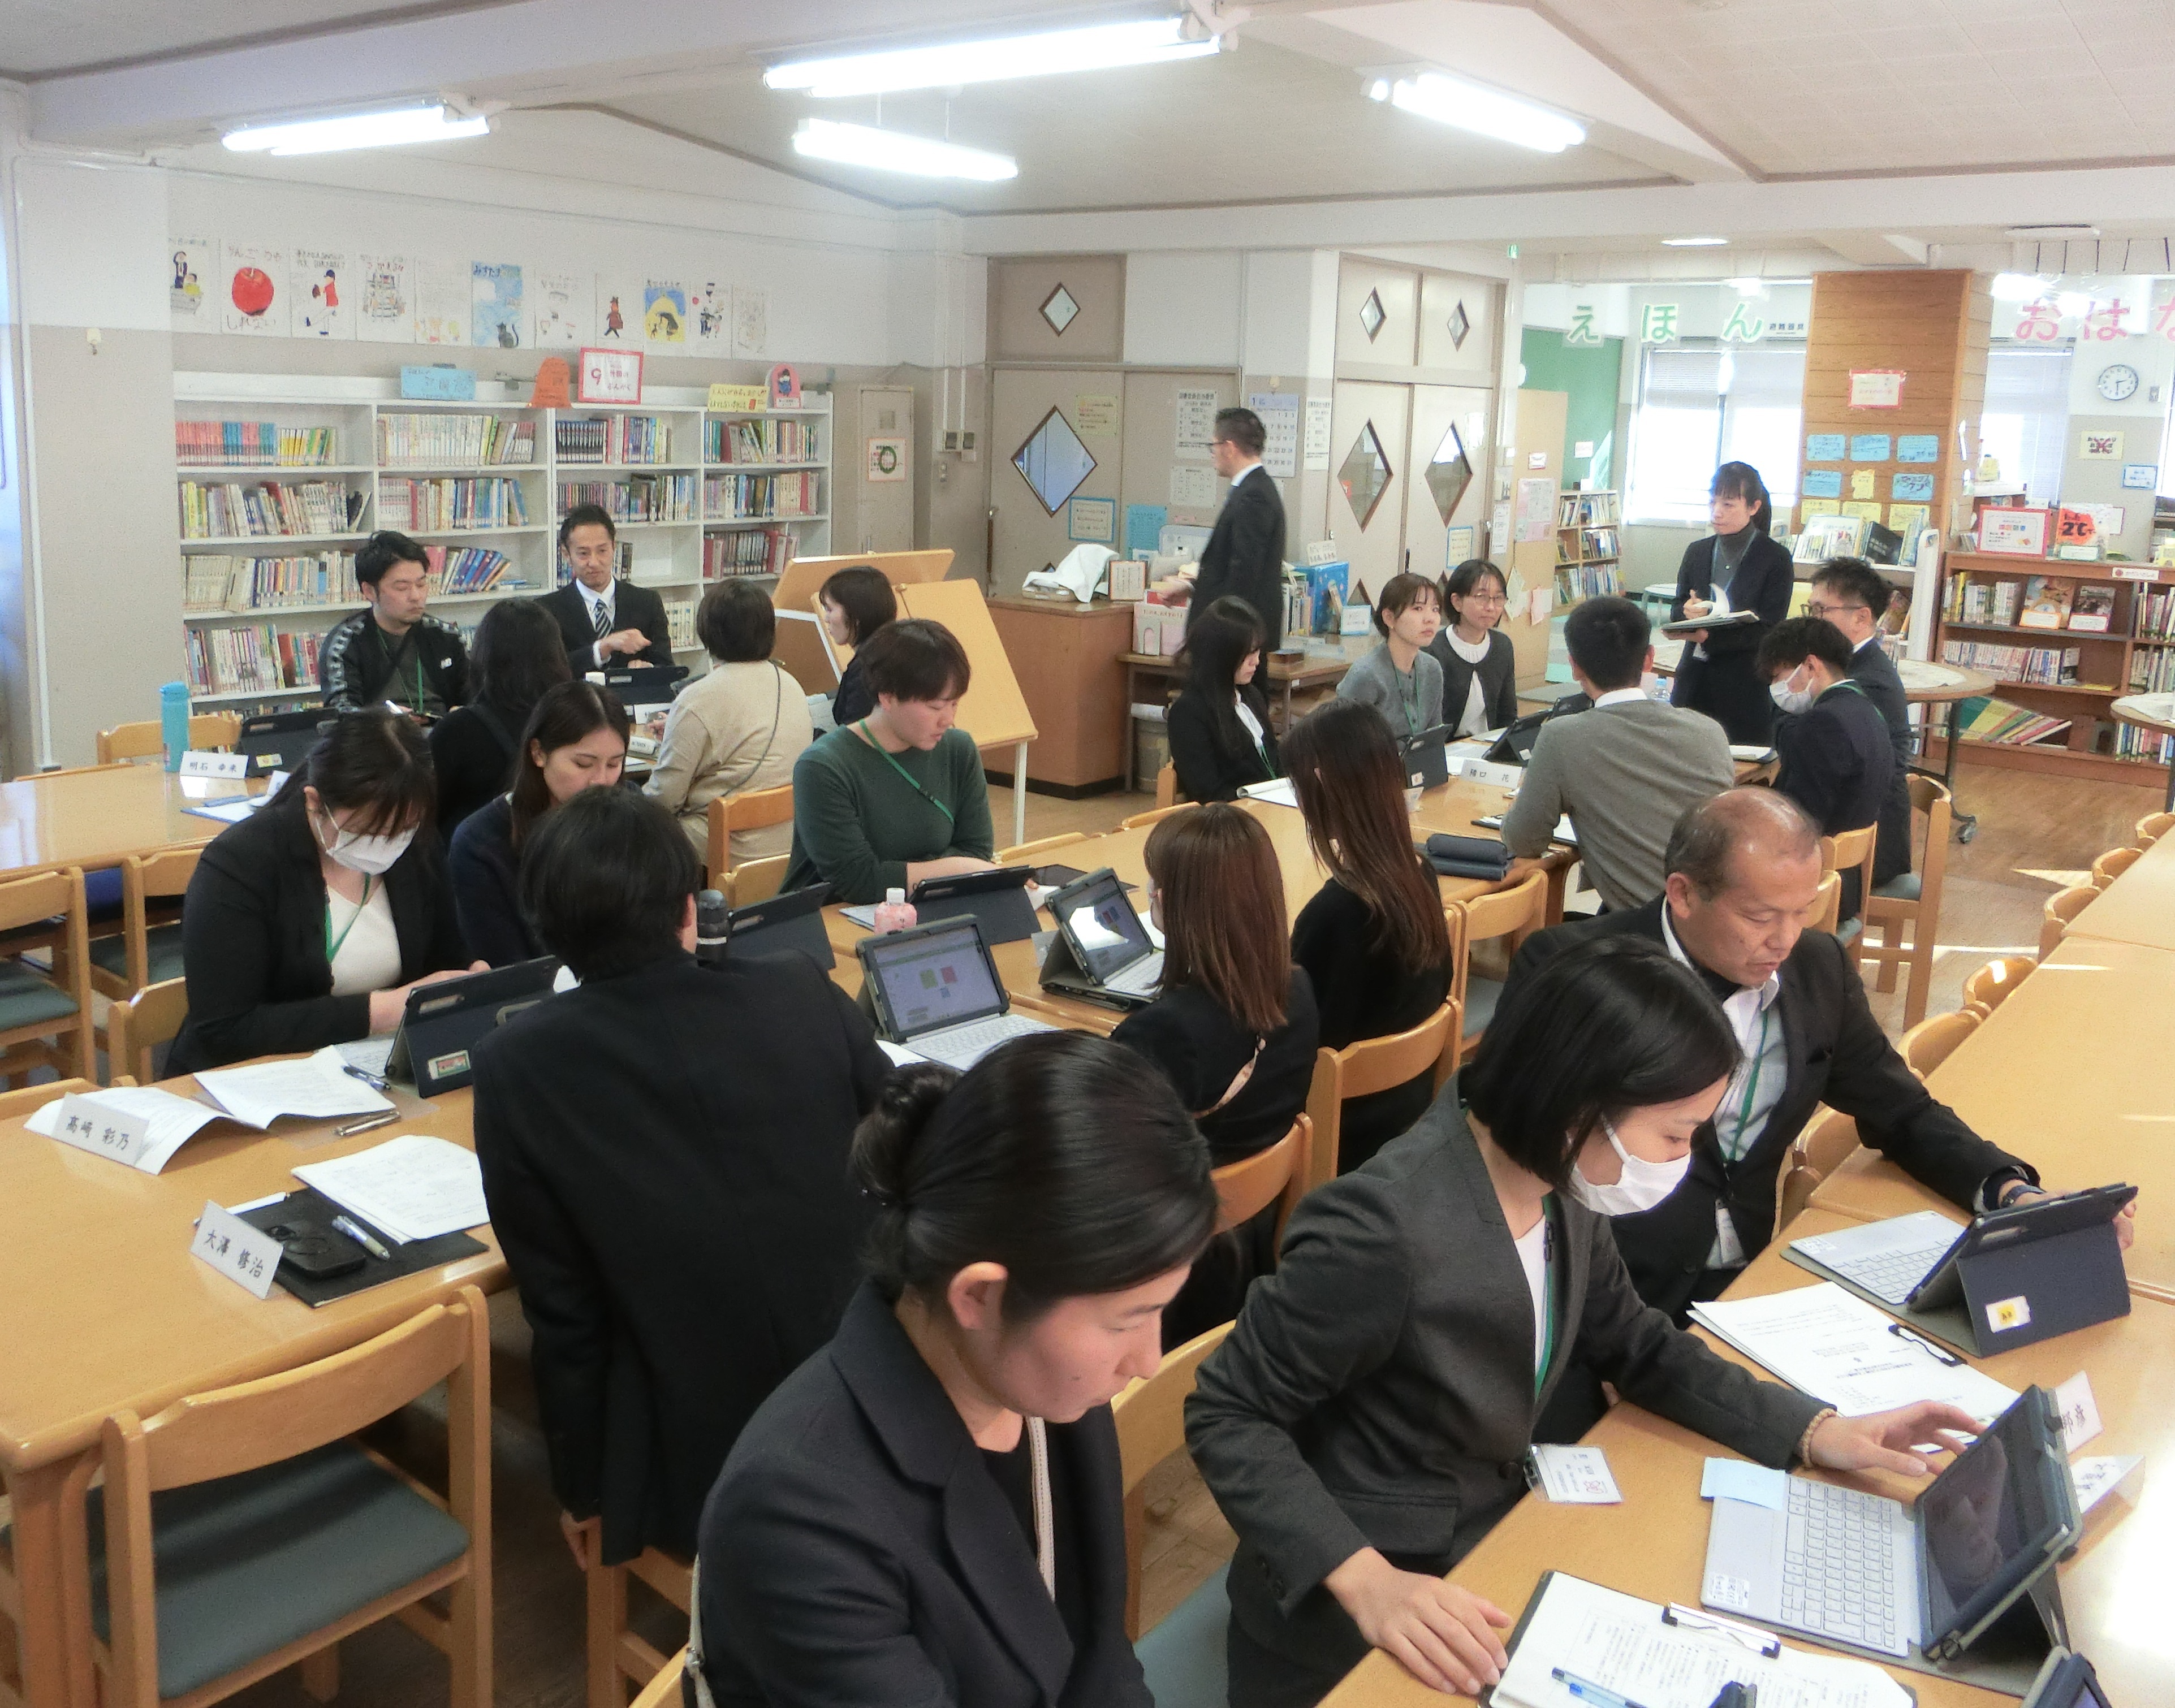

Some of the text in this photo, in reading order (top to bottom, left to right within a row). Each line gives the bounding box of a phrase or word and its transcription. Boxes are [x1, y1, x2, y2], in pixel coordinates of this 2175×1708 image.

[1569, 303, 1763, 344] えほん
[591, 368, 602, 386] 9
